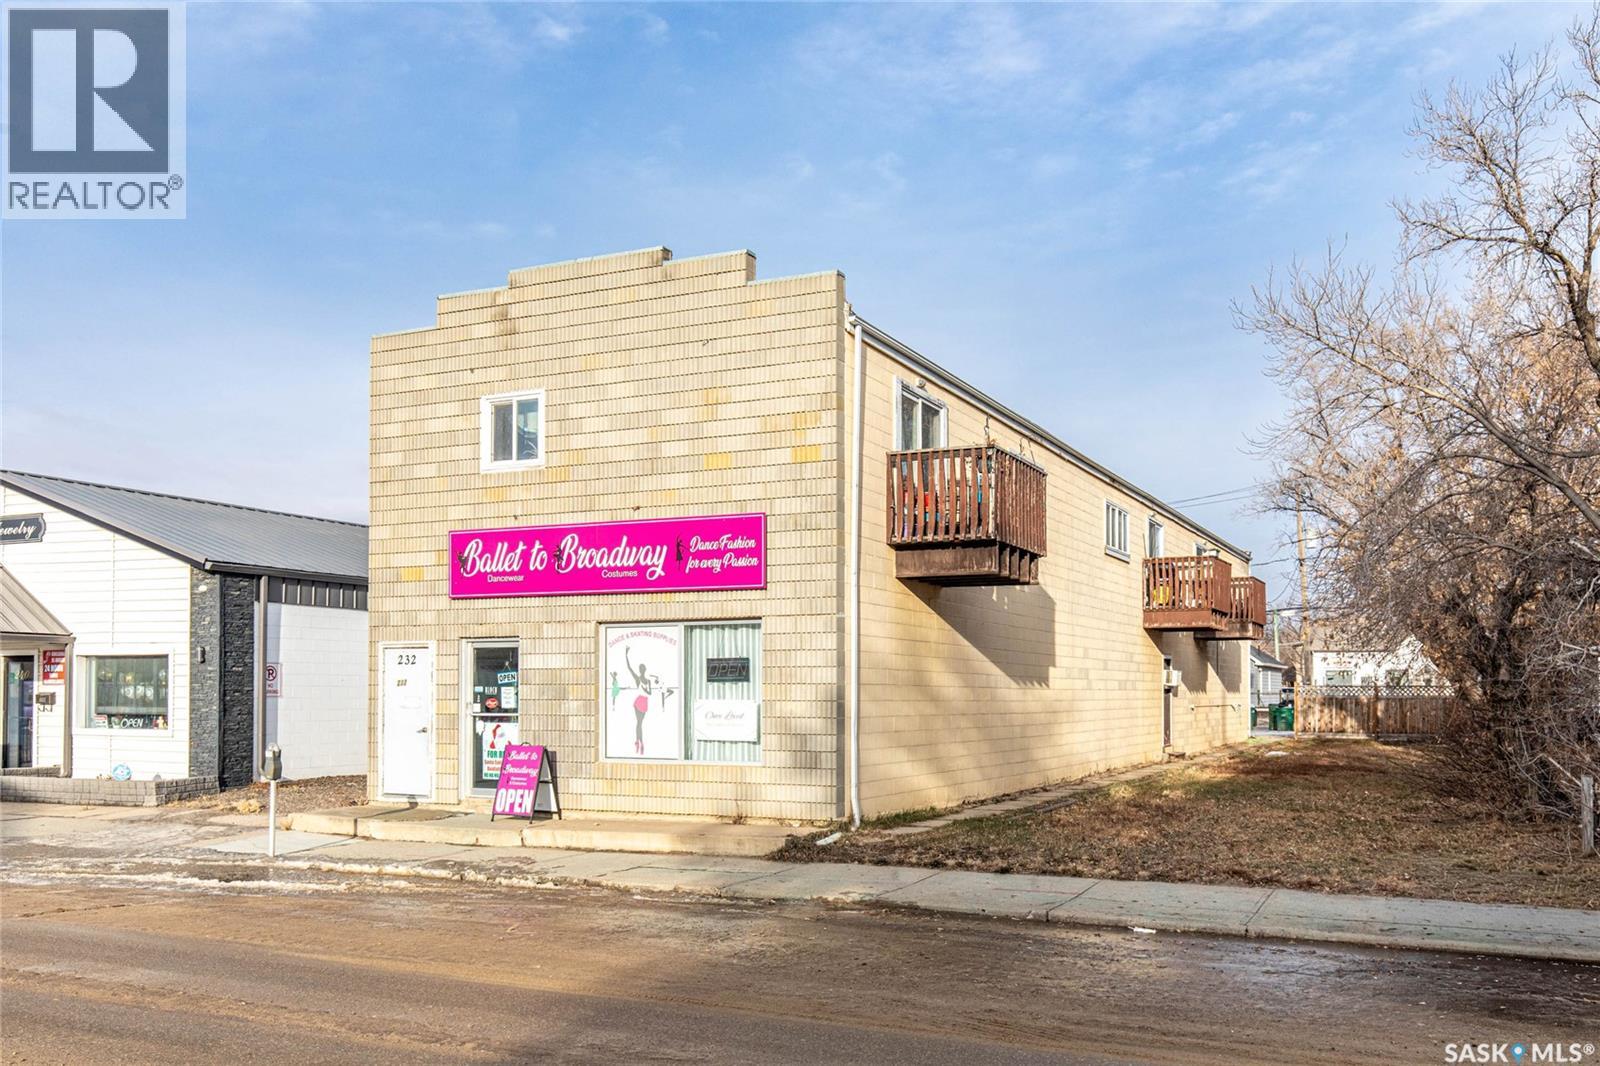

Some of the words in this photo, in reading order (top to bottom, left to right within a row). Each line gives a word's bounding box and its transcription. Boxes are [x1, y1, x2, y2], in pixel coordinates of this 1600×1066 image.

[0, 521, 37, 540] ewelry
[690, 535, 719, 553] Dance
[719, 533, 757, 551] Fashion
[462, 538, 527, 577] Ballet
[529, 540, 548, 571] to
[555, 533, 668, 581] Broadway
[685, 556, 700, 574] for
[722, 552, 759, 568] Passion
[487, 574, 524, 583] Dancewear
[601, 569, 638, 578] Costumes
[397, 654, 417, 665] 232
[708, 663, 747, 677] OPEN
[499, 673, 516, 682] OPEN
[120, 718, 144, 729] OPEN
[494, 788, 536, 814] OPEN
